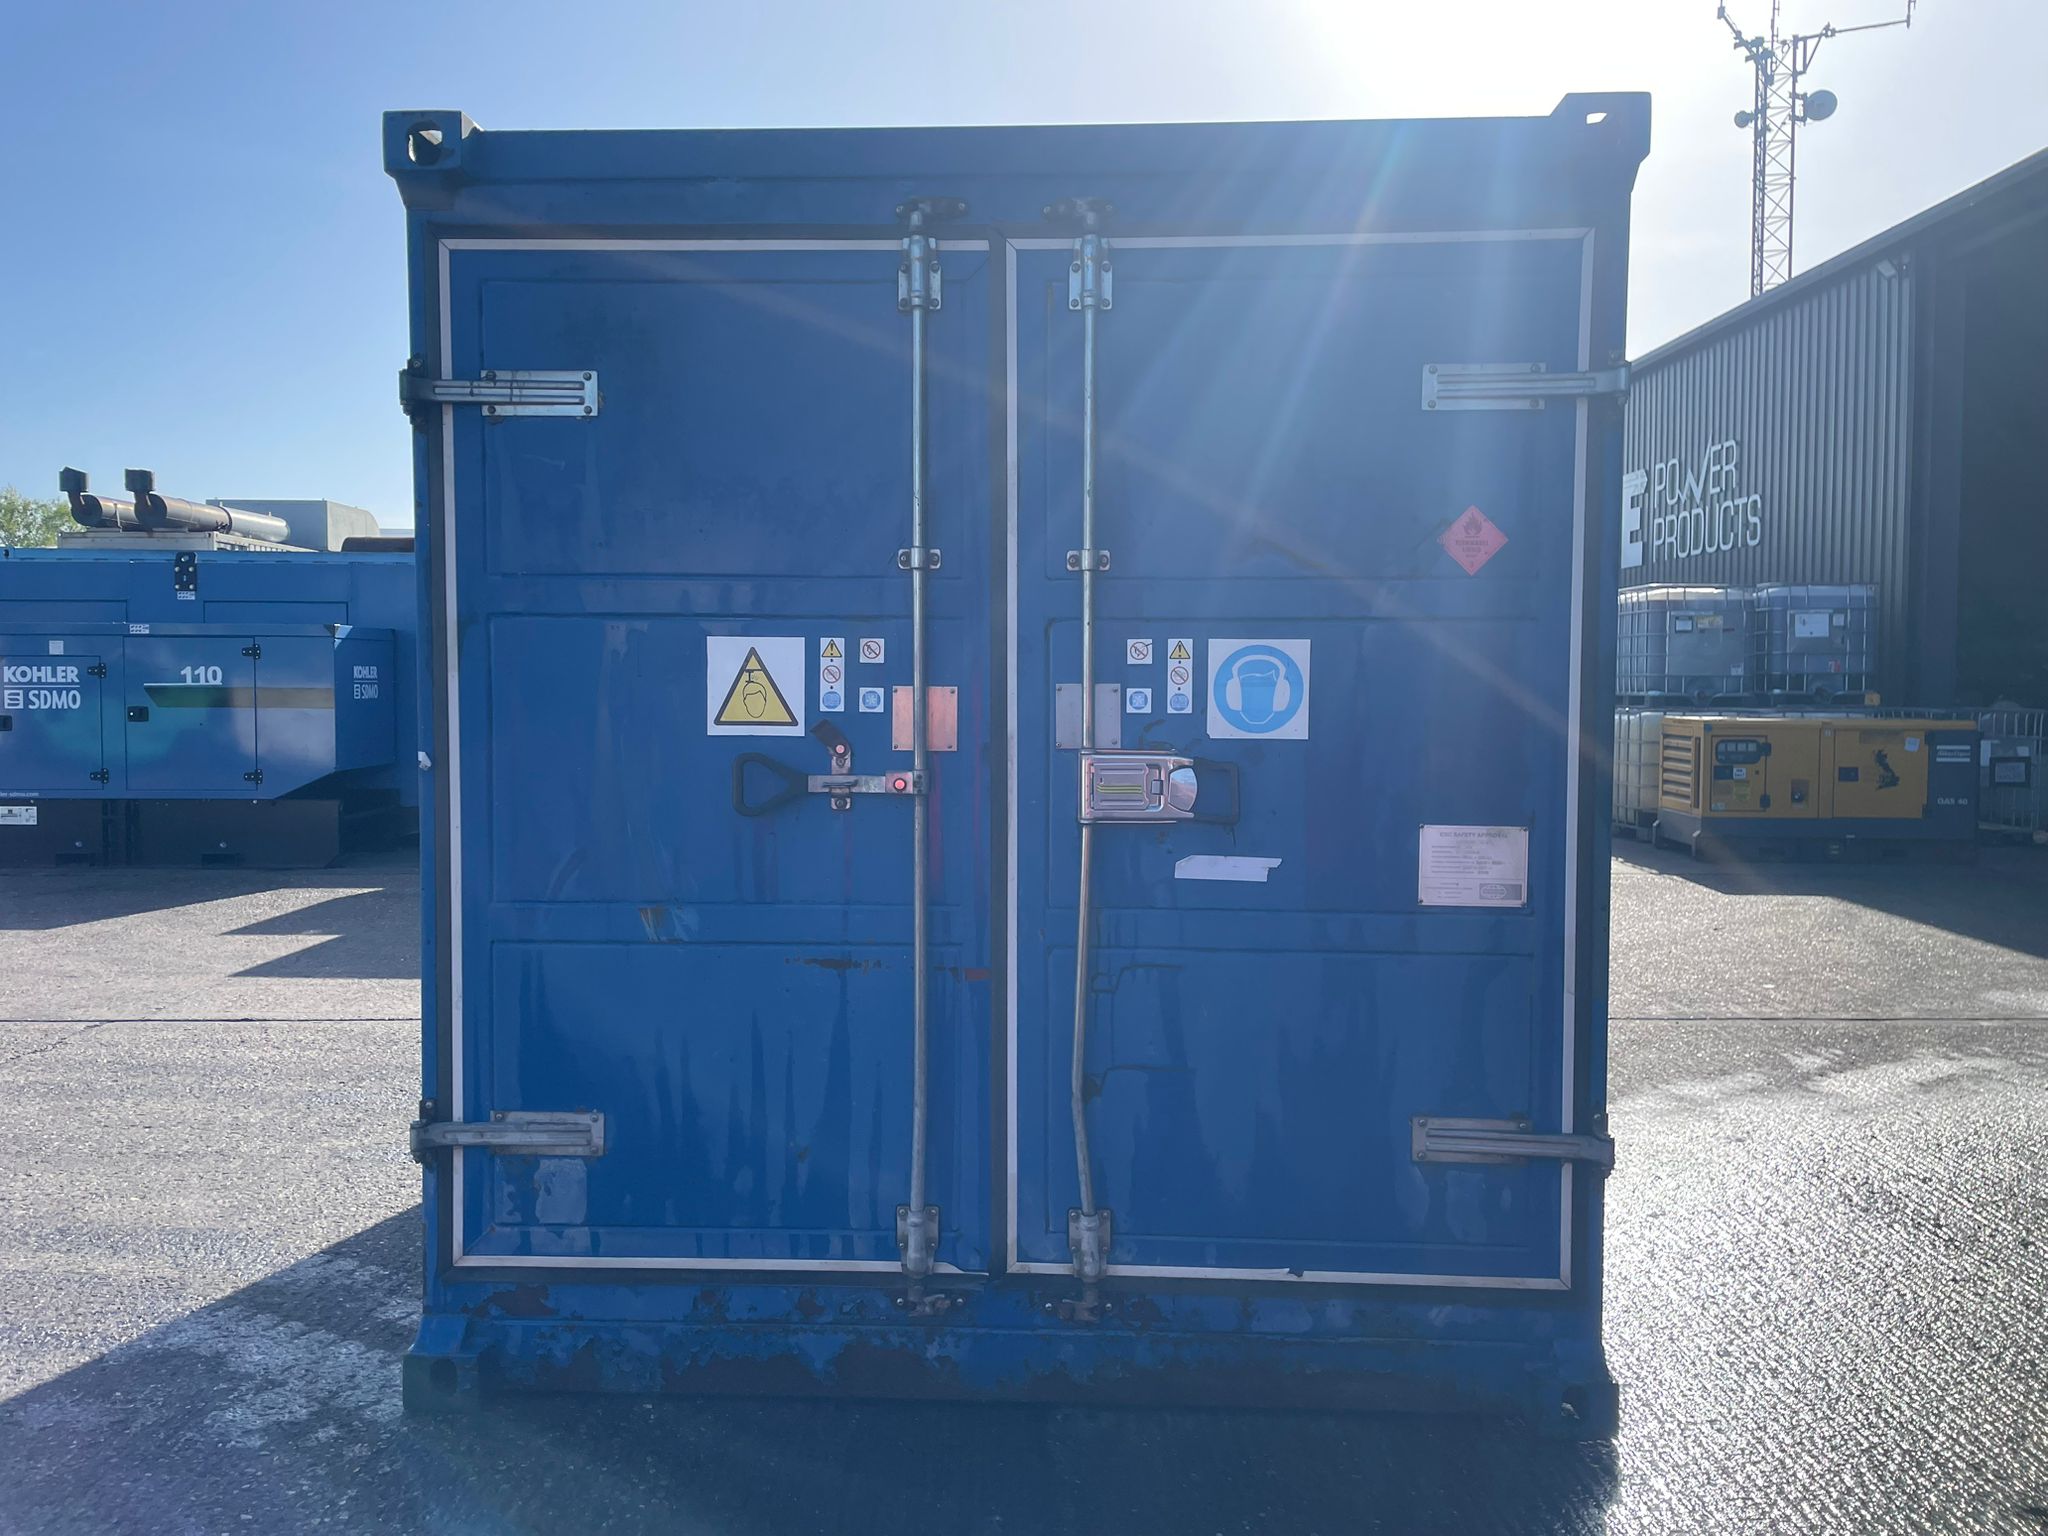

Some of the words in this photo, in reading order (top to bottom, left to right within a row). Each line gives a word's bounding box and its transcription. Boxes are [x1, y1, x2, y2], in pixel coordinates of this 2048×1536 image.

[1654, 431, 1737, 509] POWER
[1653, 494, 1761, 563] PRODUCTS
[3, 665, 80, 683] KOHLER
[180, 665, 223, 684] 110
[353, 665, 378, 679] KOHLER
[28, 689, 81, 710] SDMO
[361, 684, 379, 699] SDMO
